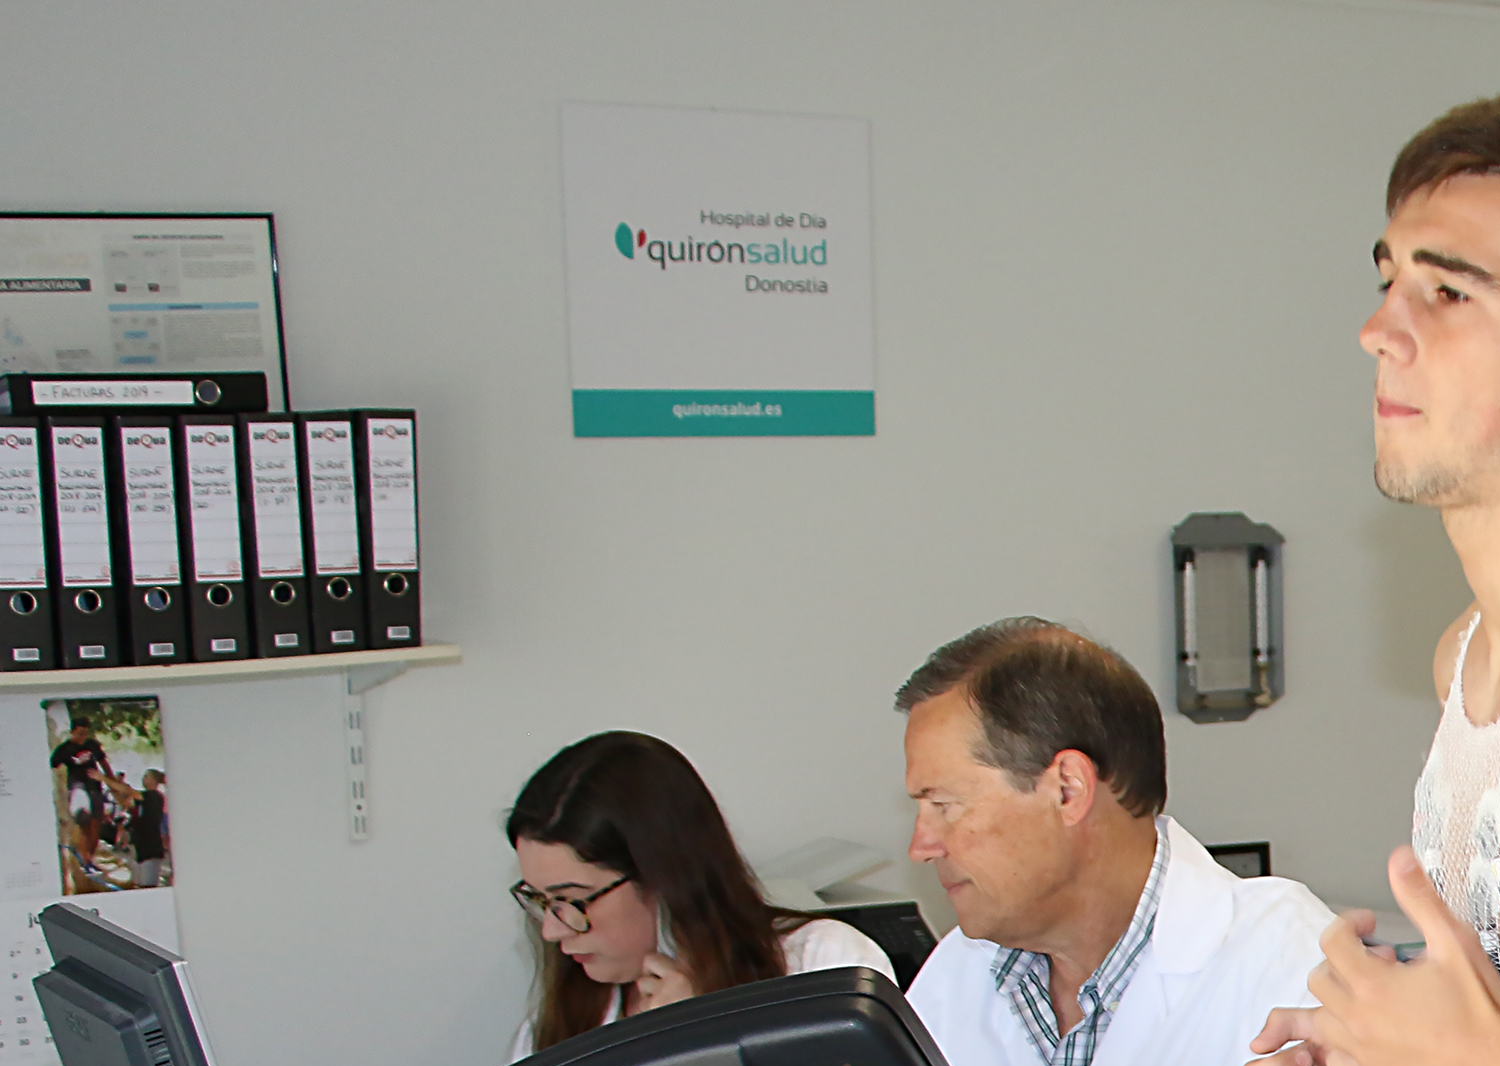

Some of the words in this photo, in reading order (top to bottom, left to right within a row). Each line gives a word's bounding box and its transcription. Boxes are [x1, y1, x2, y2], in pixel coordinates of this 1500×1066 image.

[700, 210, 770, 229] Hospital
[774, 212, 795, 228] de
[745, 274, 829, 293] Donostia
[52, 384, 115, 399] FACTURAS
[122, 385, 149, 398] 2019
[672, 402, 783, 418] quironsalud.es
